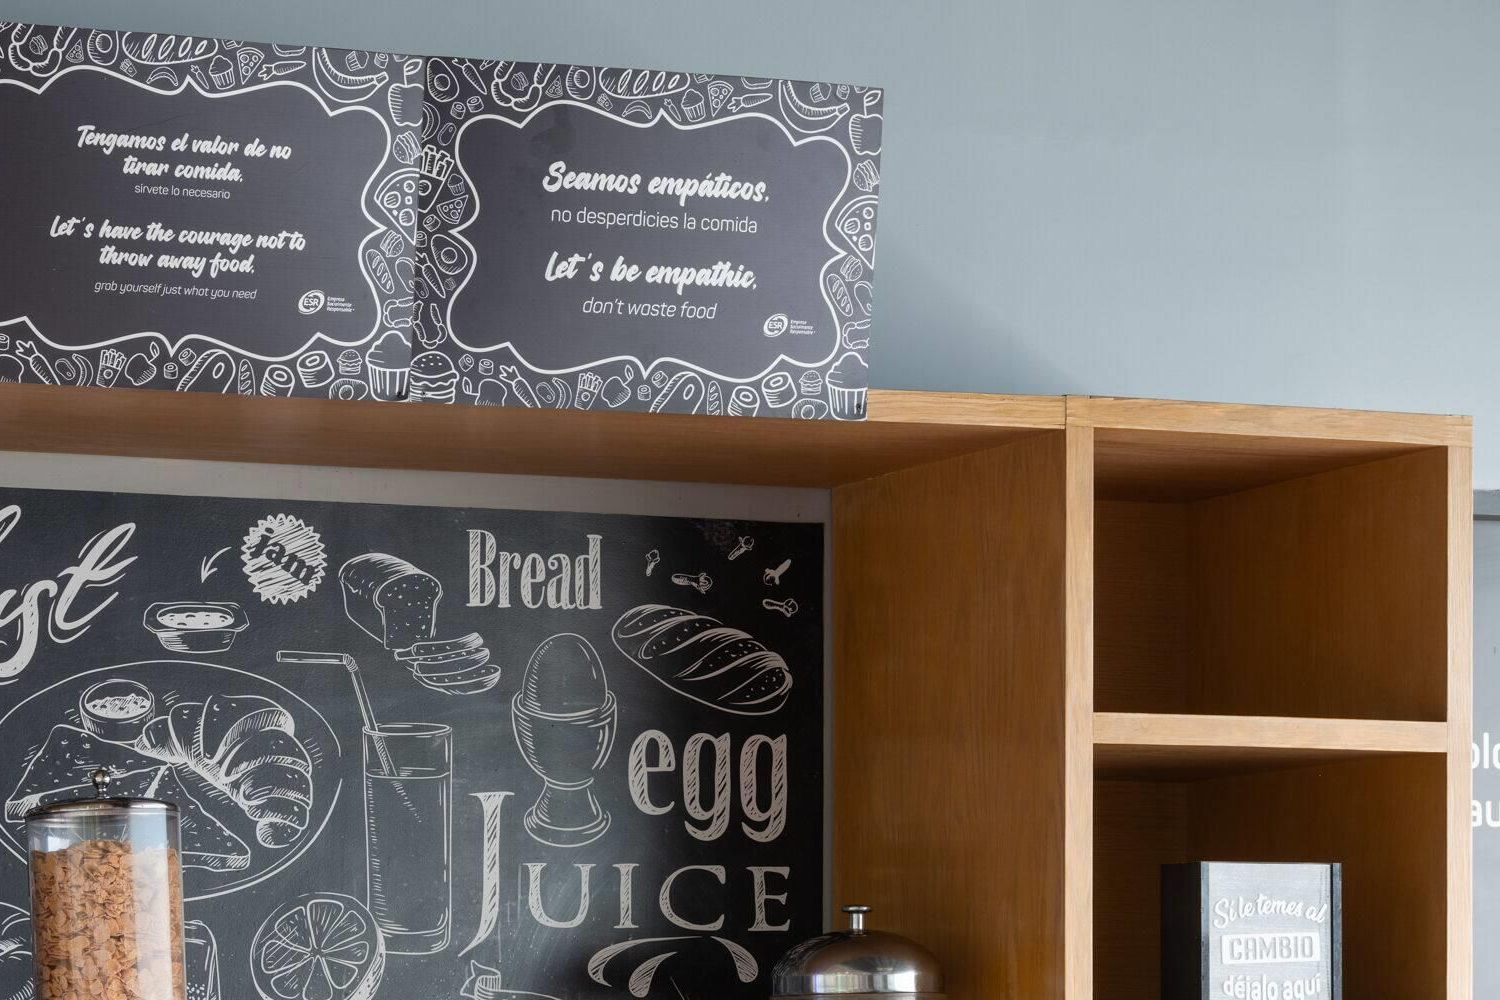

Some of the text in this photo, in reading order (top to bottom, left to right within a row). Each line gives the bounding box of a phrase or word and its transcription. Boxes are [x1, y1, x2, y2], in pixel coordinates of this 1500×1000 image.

[77, 124, 292, 160] Tengamos el valor de no
[123, 155, 169, 175] tirar
[542, 160, 641, 195] Seamos
[171, 185, 180, 196] lo
[182, 187, 231, 199] necesario
[551, 207, 758, 233] no desperdicies la comida
[99, 219, 144, 240] have
[145, 222, 175, 242] the
[178, 228, 254, 254] courage
[256, 230, 287, 249] not
[288, 231, 306, 251] to
[99, 245, 153, 267] throw
[157, 253, 207, 278] away
[610, 255, 642, 282] be
[94, 281, 257, 299] grab yourself just what you need
[304, 298, 319, 306] ESR
[628, 302, 676, 318] waste
[681, 302, 717, 320] food
[769, 321, 782, 329] ESR
[465, 528, 603, 610] Bread
[626, 729, 788, 842] egg
[457, 790, 792, 957] JUICE
[1239, 896, 1255, 918] le
[1257, 893, 1303, 916] temes
[1305, 904, 1327, 923] al
[1229, 936, 1314, 960] CAMBIO
